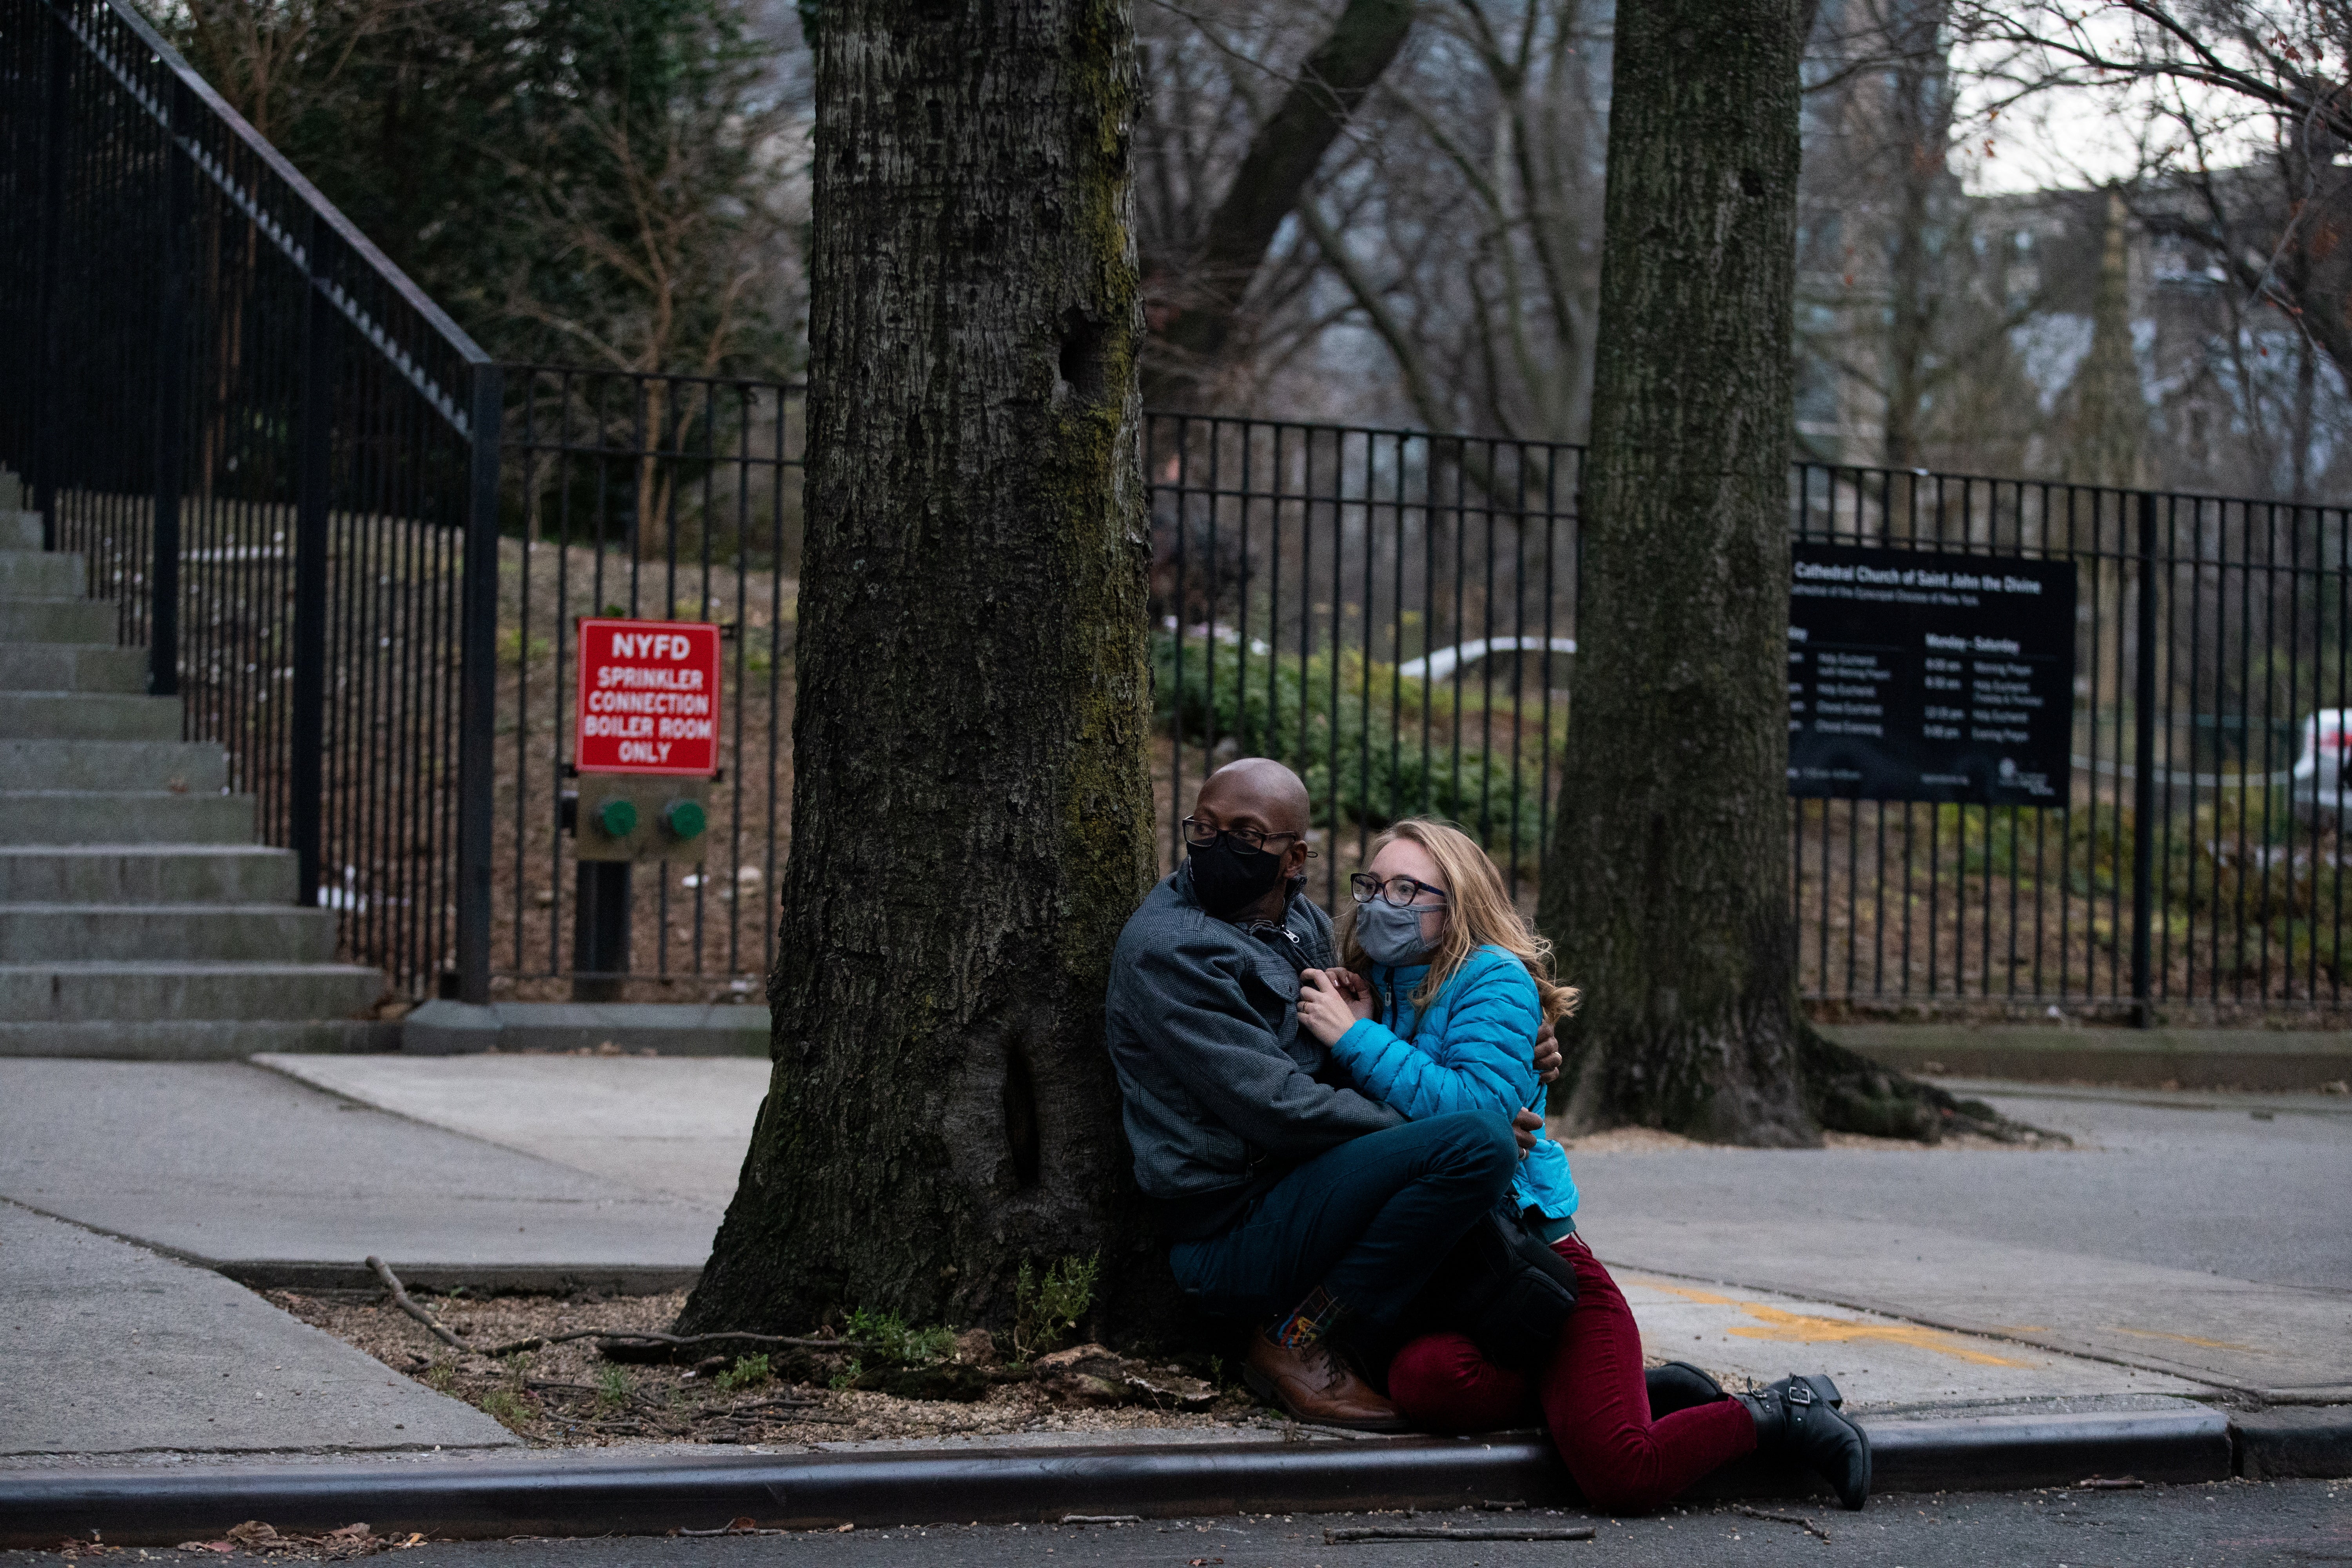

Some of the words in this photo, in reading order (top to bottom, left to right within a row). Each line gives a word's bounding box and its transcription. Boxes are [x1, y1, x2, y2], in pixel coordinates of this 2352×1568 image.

[1794, 561, 1855, 581] Cathedral
[1856, 565, 1900, 584] Church
[1902, 568, 1916, 586] of
[1917, 569, 1949, 588] Saint
[1951, 571, 1980, 590] John
[1982, 574, 2002, 592] the
[2004, 575, 2042, 595] Divine
[612, 631, 691, 661] NYFD
[597, 665, 704, 691] SPRINKLER
[588, 690, 710, 716] CONNECTION
[584, 714, 655, 738] BOILER
[658, 716, 712, 739] ROOM
[618, 739, 672, 764] ONLY
